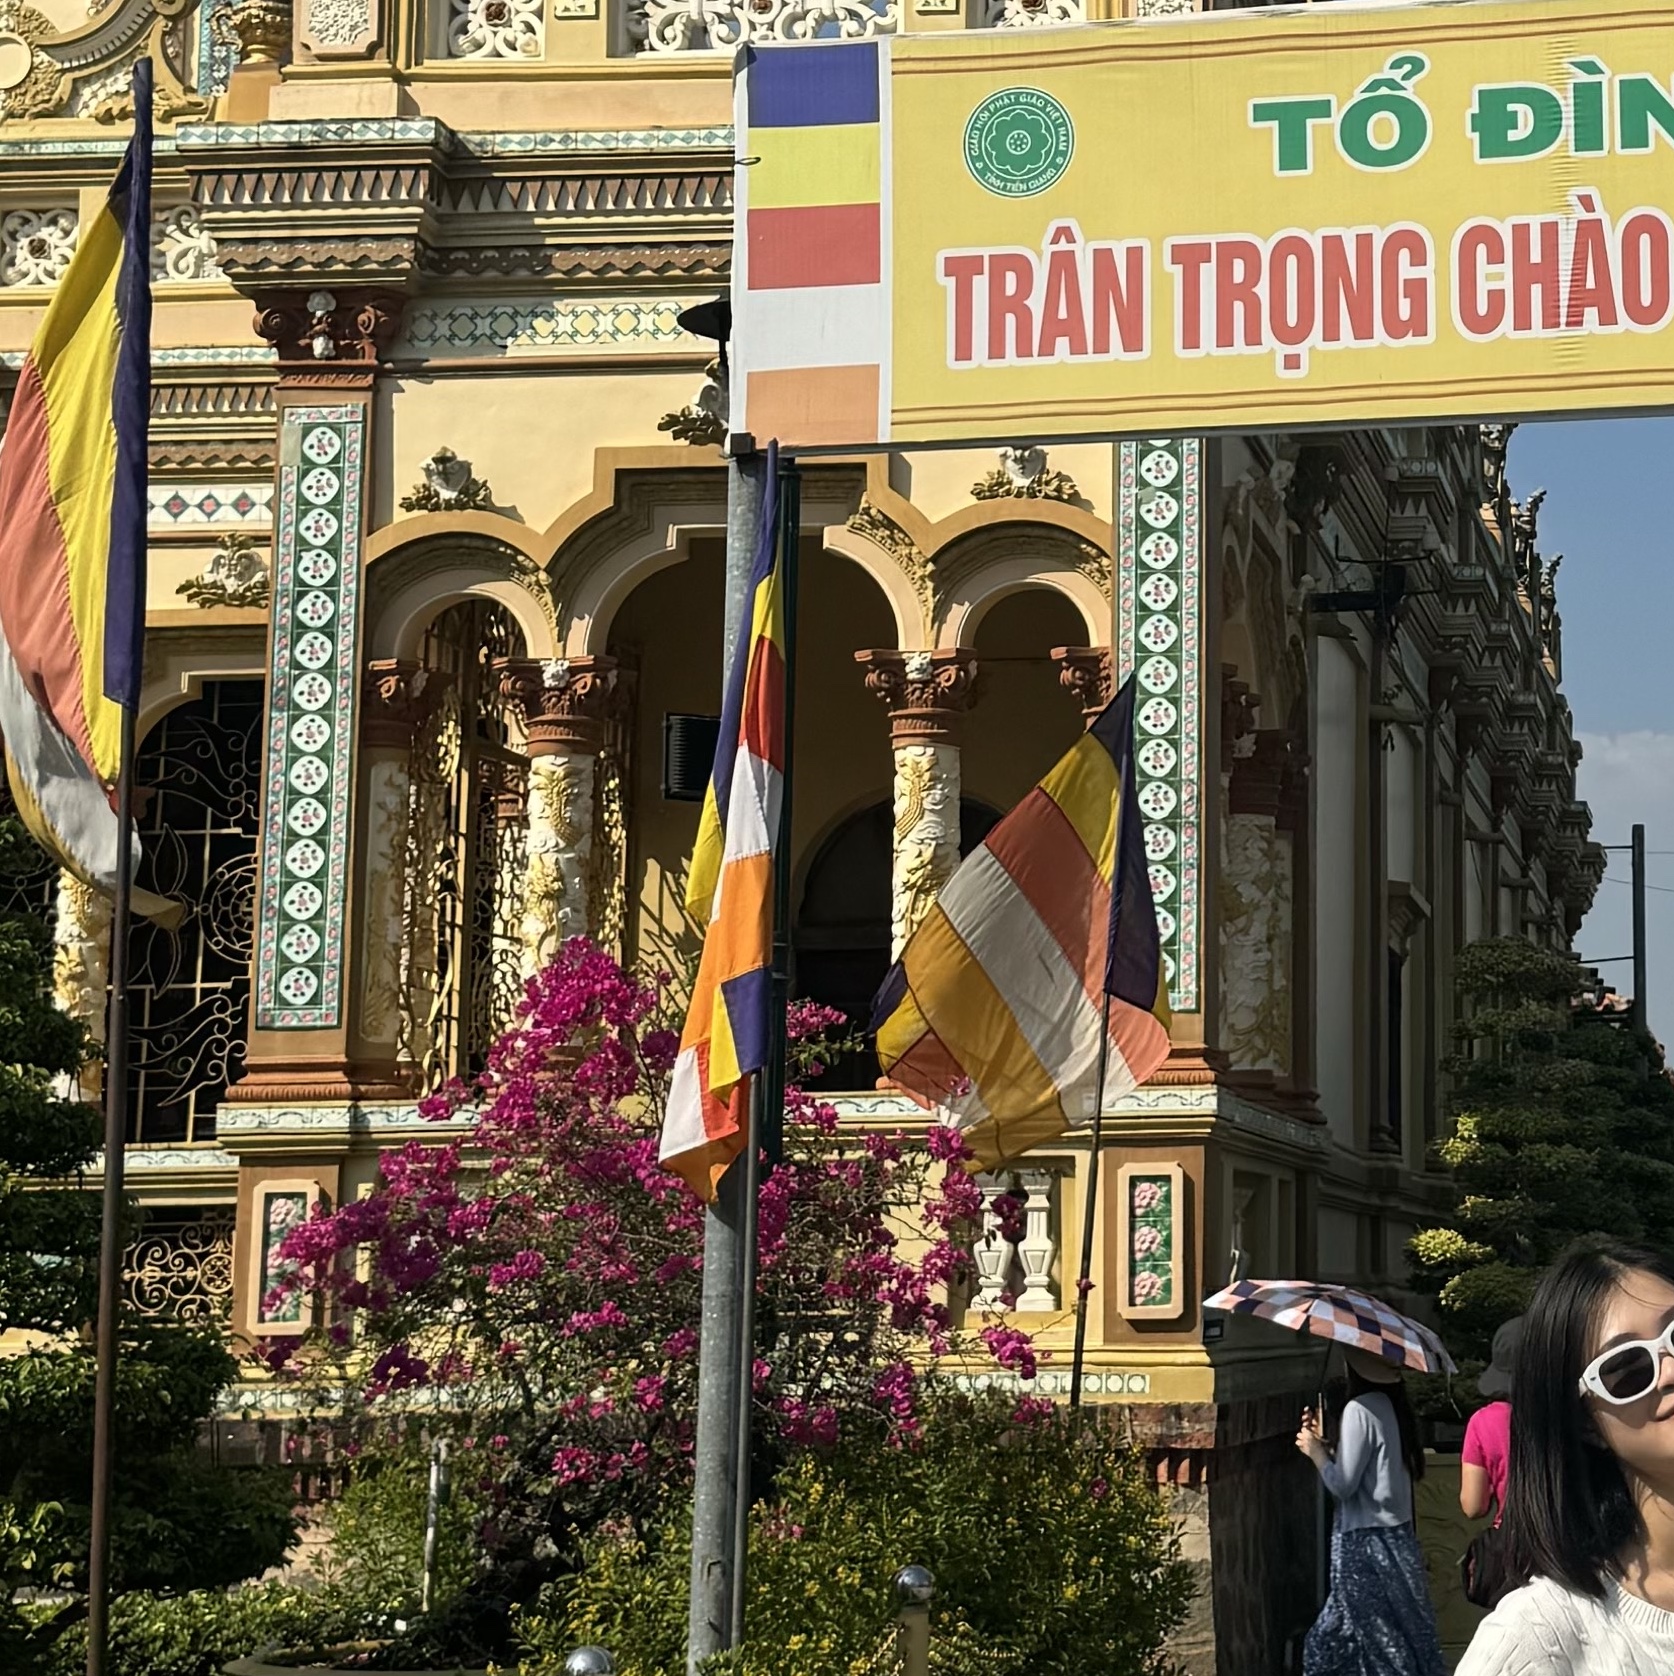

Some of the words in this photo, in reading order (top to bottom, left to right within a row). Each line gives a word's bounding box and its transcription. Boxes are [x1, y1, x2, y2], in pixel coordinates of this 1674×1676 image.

[1254, 54, 1426, 170] TỔ
[945, 226, 1143, 359] TRÂN
[1171, 231, 1427, 371] TRỌNG
[1459, 194, 1669, 339] CHÀO
